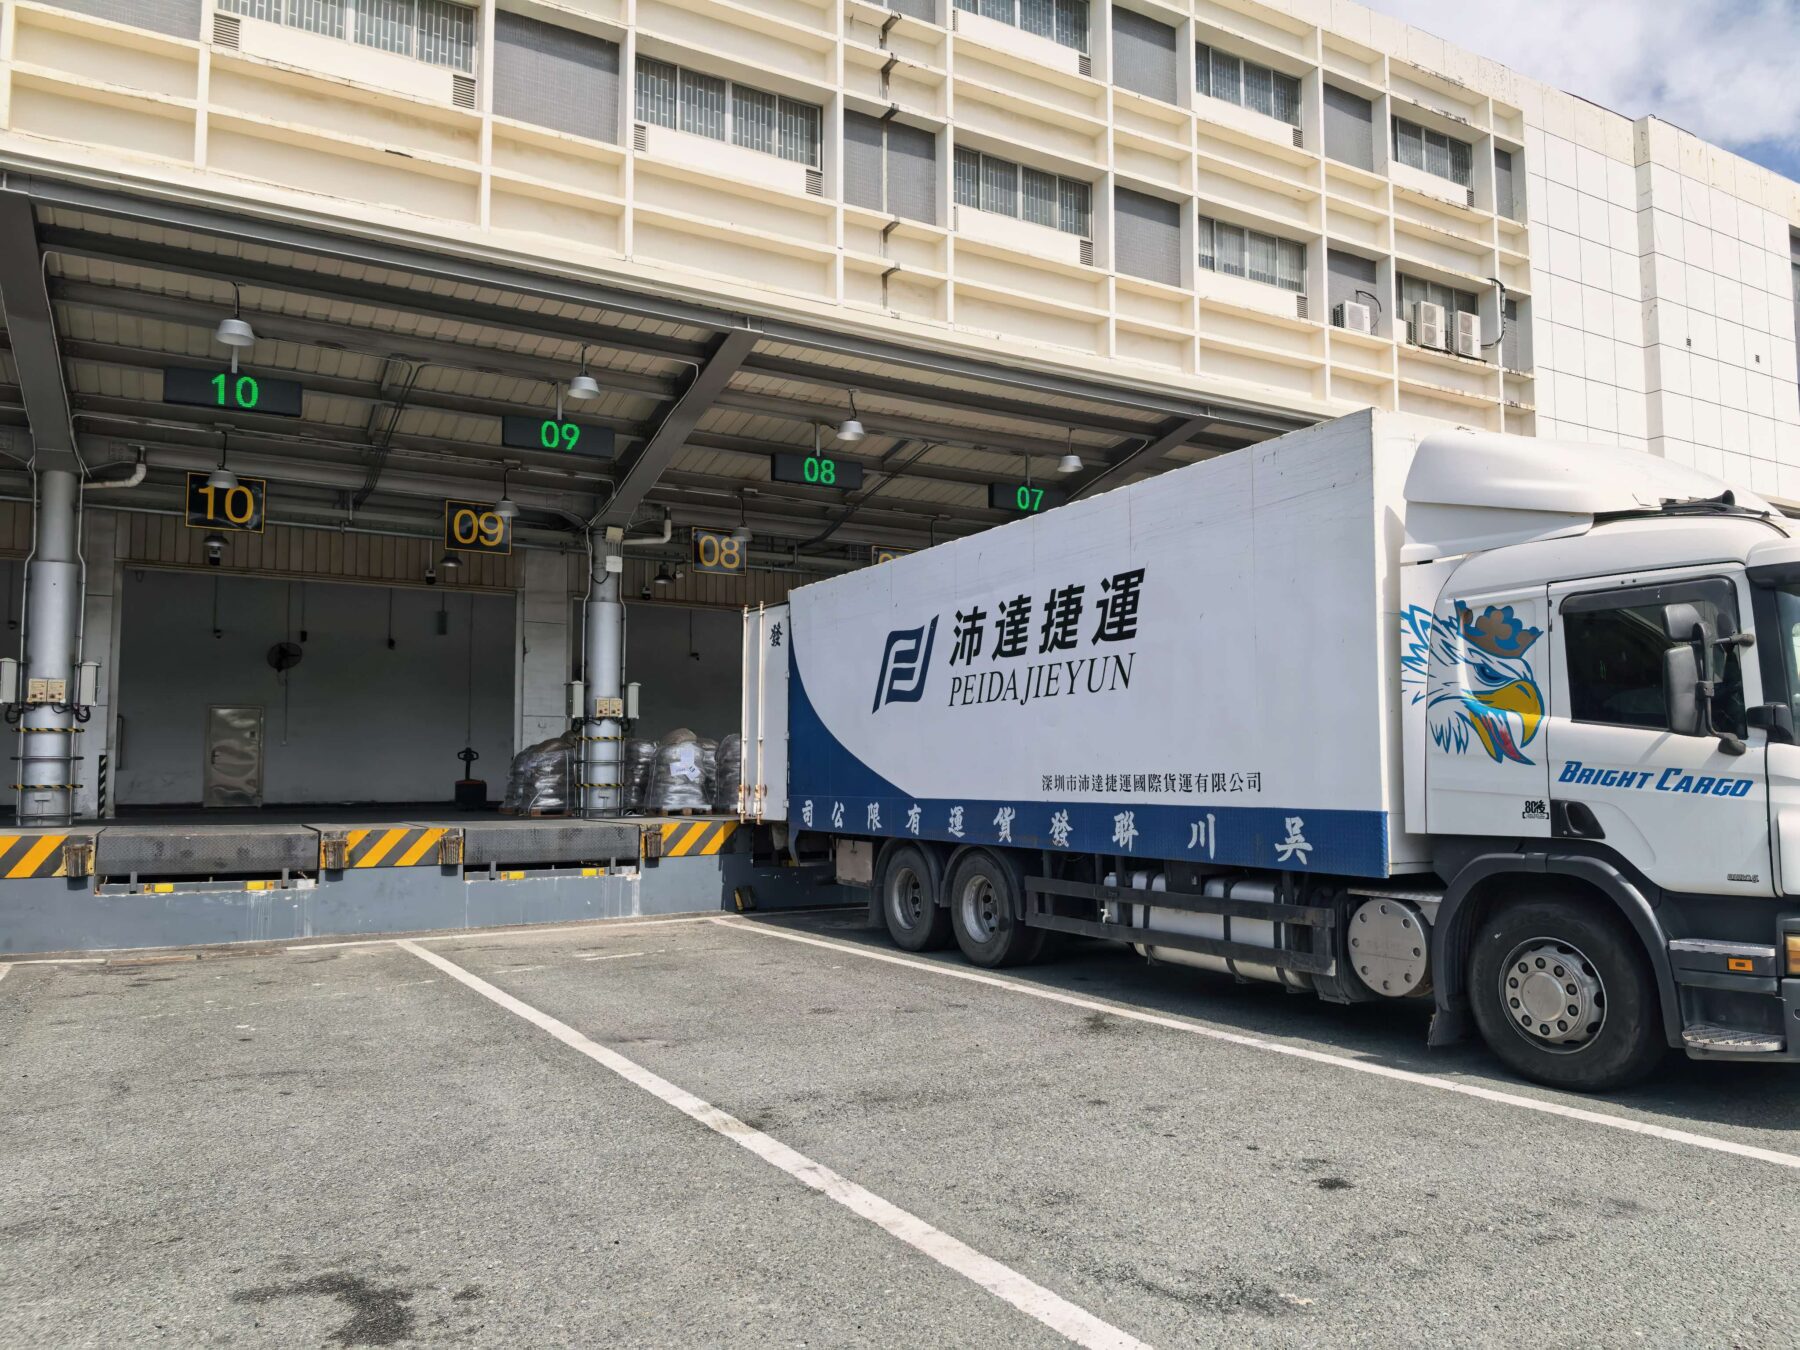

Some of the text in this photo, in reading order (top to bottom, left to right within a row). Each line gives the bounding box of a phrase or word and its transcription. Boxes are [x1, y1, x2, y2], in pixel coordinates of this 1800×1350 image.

[212, 373, 259, 409] 10
[540, 420, 581, 451] 09
[803, 457, 836, 485] 08
[198, 485, 255, 524] 10
[1017, 486, 1044, 512] 07
[453, 508, 505, 547] 09
[699, 535, 741, 569] 08
[949, 567, 1146, 667] 沛達捷運
[948, 652, 1137, 707] PEIDAJIEYUN
